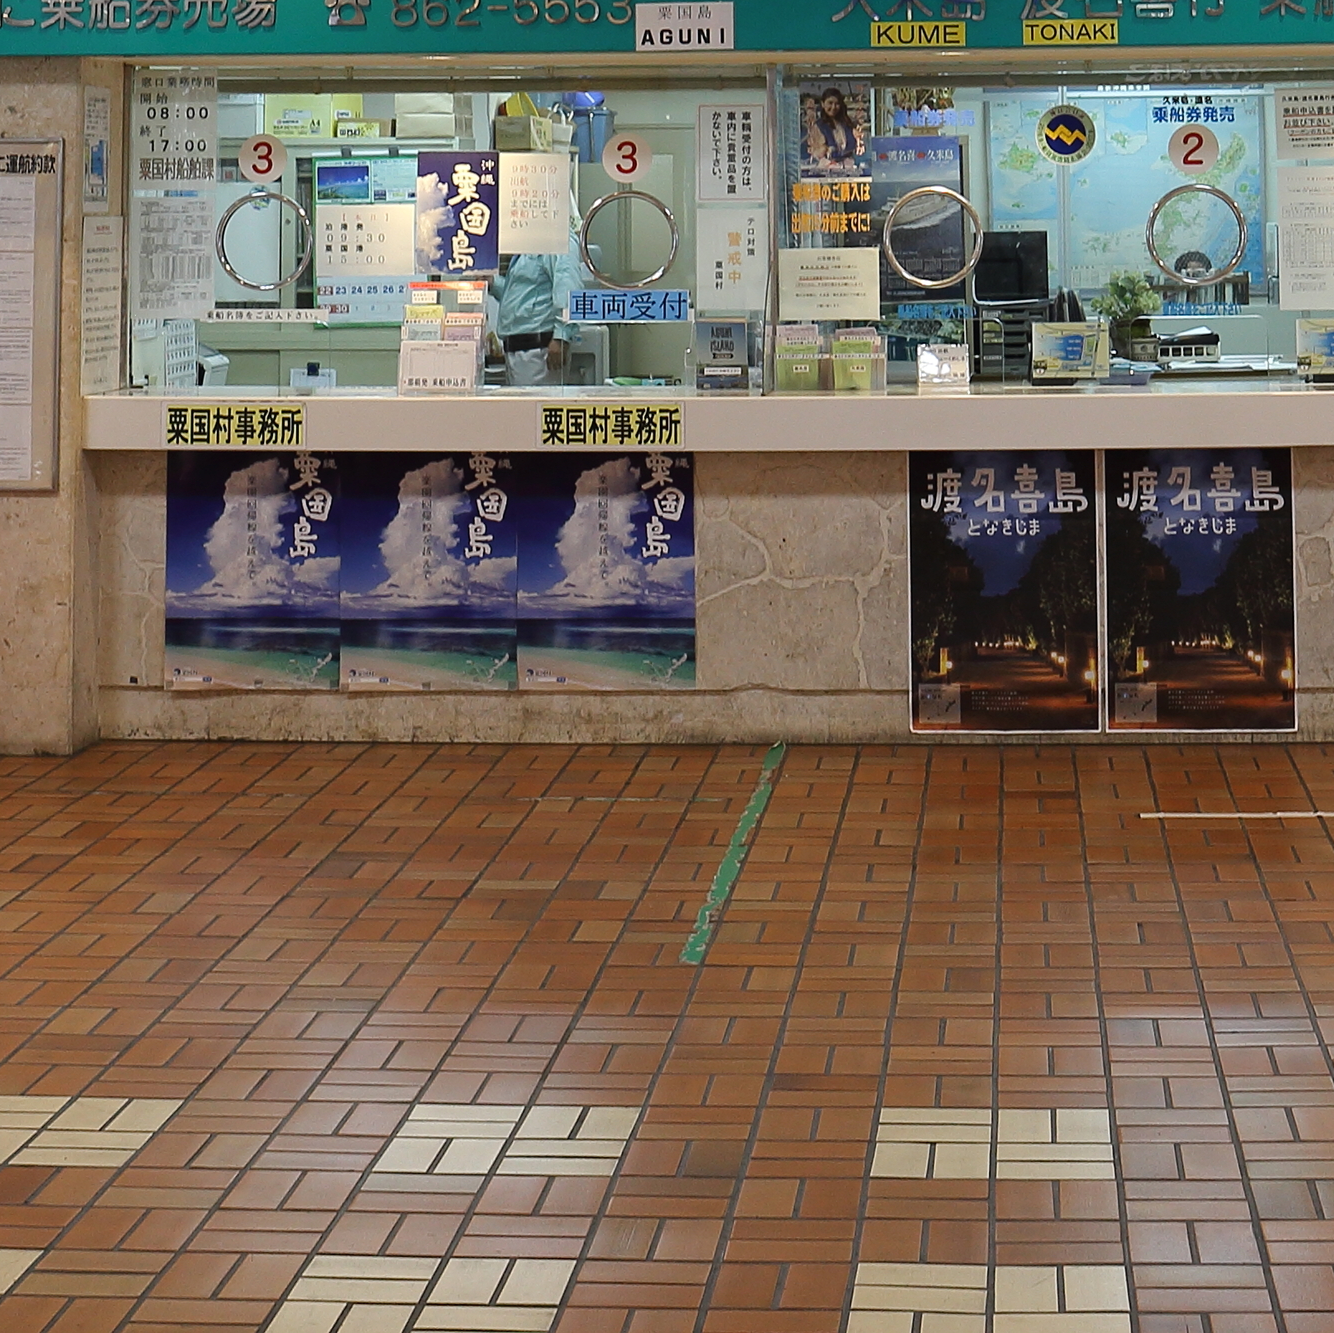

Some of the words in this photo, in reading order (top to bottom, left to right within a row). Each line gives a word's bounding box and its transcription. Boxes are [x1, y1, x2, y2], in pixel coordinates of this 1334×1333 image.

[639, 27, 727, 47] AGUNI
[875, 23, 962, 46] KUME
[1024, 21, 1117, 43] TONAKI
[147, 106, 209, 120] 08:00
[1152, 105, 1236, 123] 乗船券発売
[148, 139, 207, 152] 17:00
[252, 141, 273, 174] 3
[616, 141, 638, 173] 3
[1182, 132, 1204, 165] 2
[448, 163, 491, 270] 粟国島
[571, 292, 688, 321] 車両受付
[166, 406, 303, 445] 粟国村事務所
[542, 406, 681, 445] 粟国村事務所
[920, 464, 1089, 514] 渡名喜島
[1116, 461, 1285, 512] 渡名喜島
[967, 517, 1041, 536] となきじま
[1163, 516, 1237, 535] となきじま
